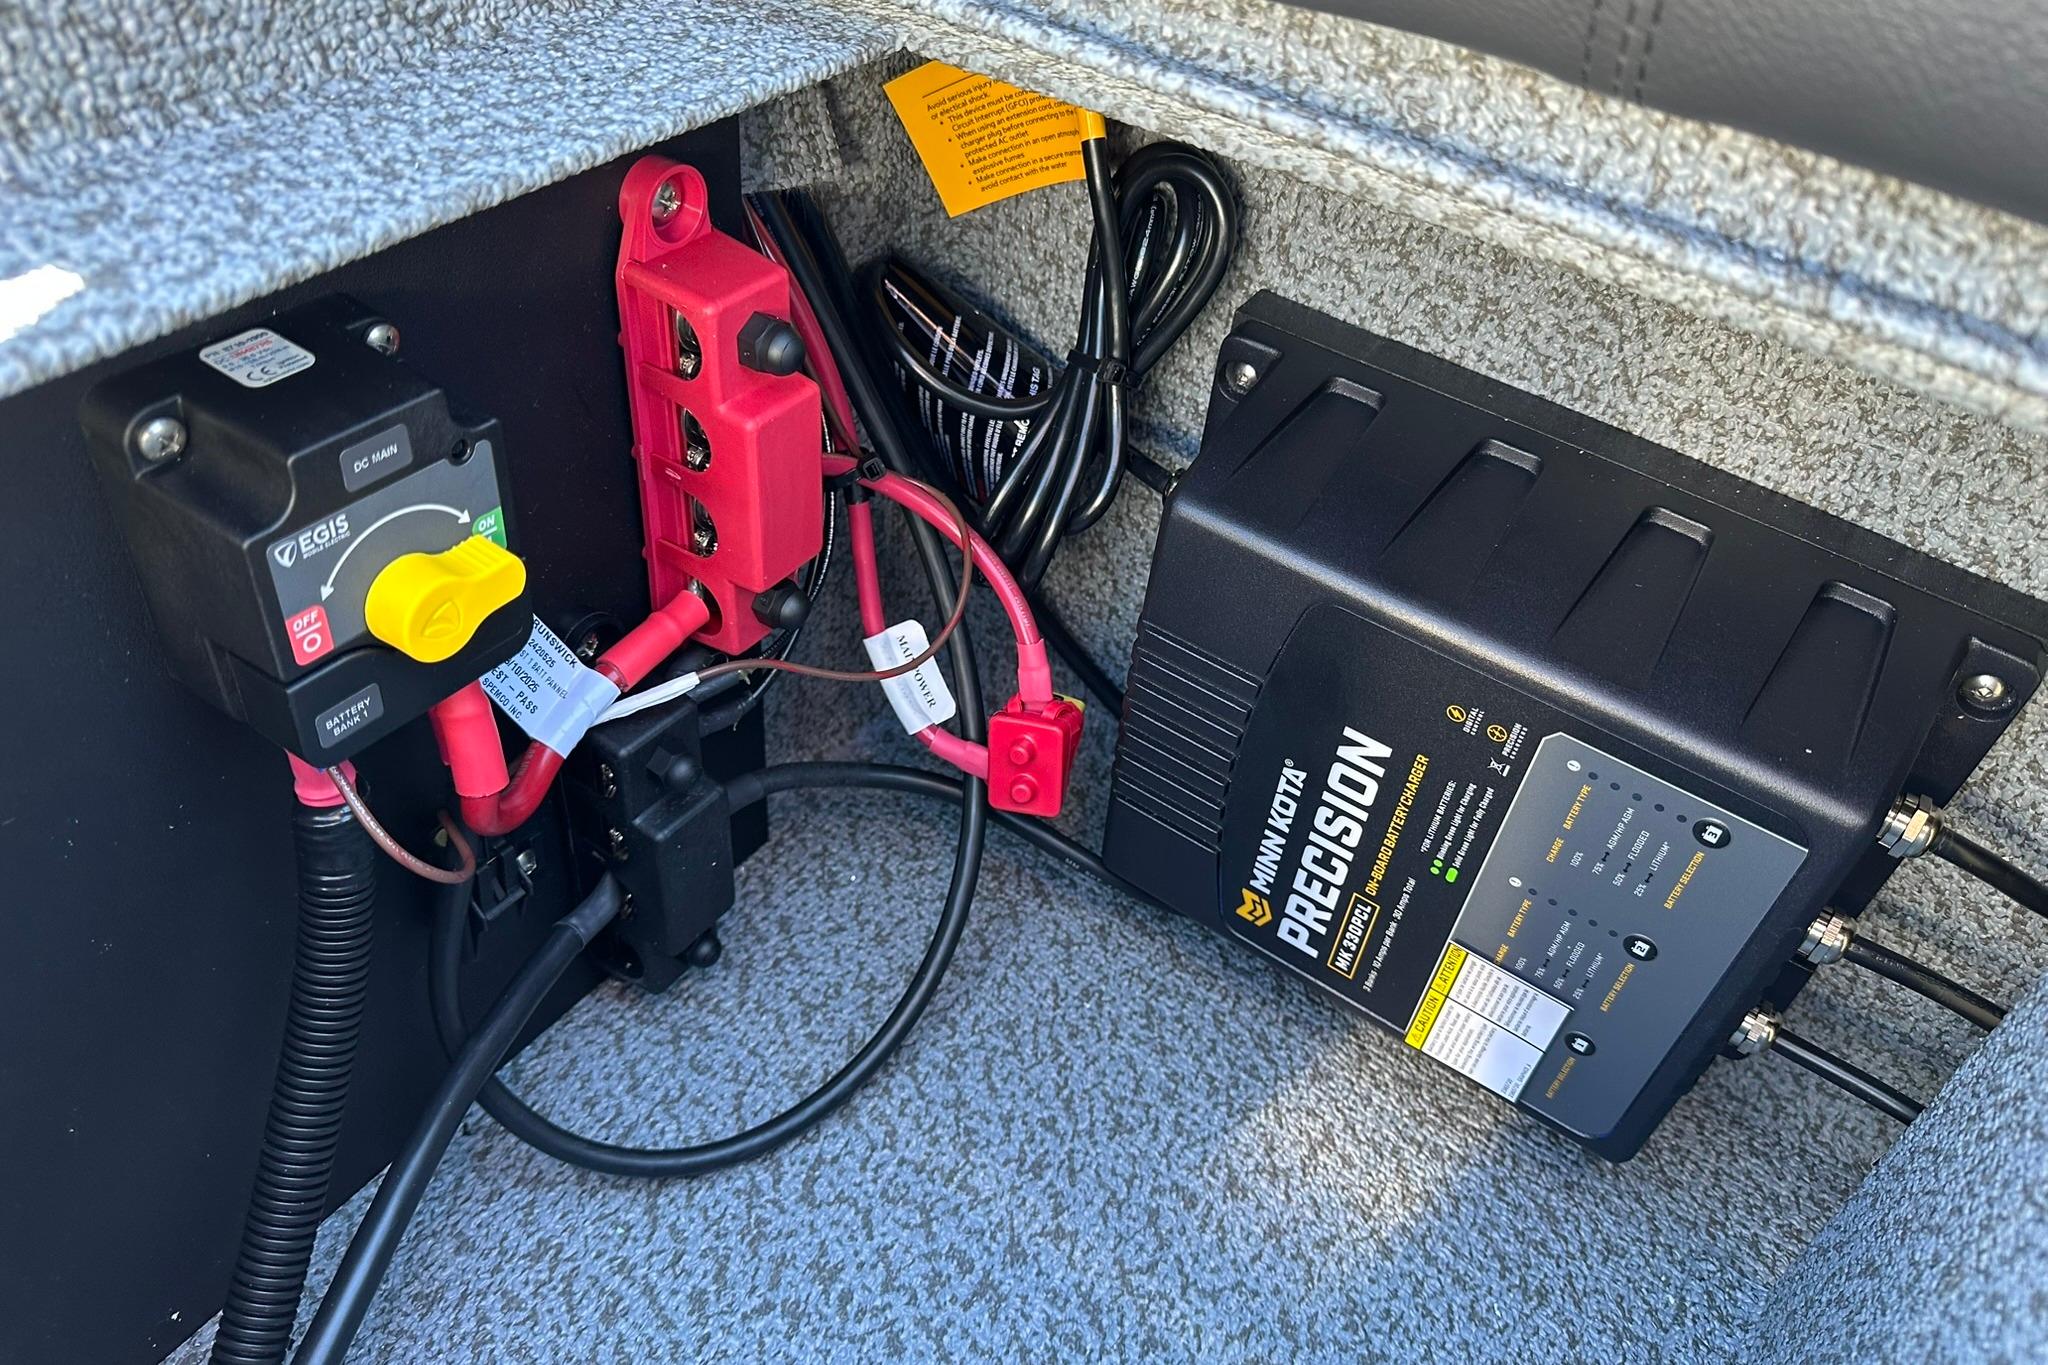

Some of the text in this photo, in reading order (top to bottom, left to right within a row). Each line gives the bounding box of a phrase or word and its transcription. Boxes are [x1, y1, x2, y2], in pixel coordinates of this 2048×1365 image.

[927, 80, 992, 112] Avoid serious injury
[948, 113, 963, 123] This
[963, 104, 986, 117] device
[986, 96, 1004, 108] must
[968, 91, 989, 104] shock.
[951, 97, 1029, 132] Circuit Interrupt (GFCI)
[955, 129, 976, 140] When
[976, 121, 996, 133] using
[1005, 107, 1037, 122] extension
[1038, 102, 1053, 112] cord,
[960, 135, 986, 149] charger
[987, 129, 1003, 140] plug
[1001, 121, 1024, 134] before
[1025, 112, 1059, 126] connecting
[964, 130, 1029, 159] protected AC outlet
[968, 156, 987, 166] Make
[987, 142, 1024, 159] connection
[1040, 133, 1056, 143] open
[1003, 152, 1024, 163] fumes
[976, 172, 995, 183] Make
[996, 161, 1031, 177] connection
[1043, 152, 1064, 162] secure
[981, 161, 1067, 192] avoid contact with the water
[1031, 366, 1041, 384] TAG
[354, 443, 398, 473] DC MAIN
[298, 513, 349, 554] EGIS
[478, 515, 496, 532] ON
[303, 530, 351, 560] MOBILE ELECTRIC
[293, 611, 319, 633] OFF
[527, 638, 557, 668] 2420525
[533, 618, 578, 669] RUNSWICK
[533, 661, 548, 677] BATT
[545, 676, 569, 700] PANNEL
[325, 696, 371, 731] BATTERY
[481, 677, 522, 722] SPEMCO INC.
[515, 690, 539, 715] PASS
[333, 713, 361, 737] BANK
[1462, 707, 1479, 733] DIGITAL
[1502, 723, 1522, 757] PRECISION
[1426, 814, 1442, 840] LITHIUM
[1436, 780, 1457, 815] BATTERIES:
[1436, 783, 1477, 860] Blinking Green Light for Charging
[1546, 784, 1592, 863] CHARGE BATTERY TYPE
[1276, 725, 1393, 959] PRECISION
[1452, 786, 1494, 868] Solid Green Light for Fully Charged
[1592, 807, 1635, 875] 75% AGM/HP AGM
[1249, 829, 1286, 895] MINN
[1335, 754, 1429, 971] MK 330PCL ON-BOARD BATTERY CHARGER
[1570, 851, 1584, 867] 100%
[1612, 830, 1650, 886] 50% FLOODED
[1403, 876, 1416, 894] Total
[1633, 883, 1647, 897] 25%
[1664, 851, 1705, 909] BATTERY SELECTION
[1392, 909, 1403, 920] 30
[1396, 893, 1410, 912] Amps
[1385, 921, 1398, 937] Bank
[1507, 912, 1524, 938] BATTERY
[1519, 899, 1532, 914] TYPE
[1375, 945, 1388, 963] Amps
[1382, 935, 1392, 948] per
[1534, 920, 1571, 978] 75% AGM/HP AGM
[1364, 970, 1378, 987] Banks
[1372, 960, 1381, 969] 10
[1438, 947, 1463, 984] ATTENTION
[1514, 957, 1527, 971] 100%
[1553, 941, 1585, 989] 50% FLOODED
[1572, 988, 1584, 1000] 25%
[1600, 962, 1635, 1012] BATTERY SELECTION
[1414, 995, 1439, 1033] CAUTION
[1556, 1056, 1576, 1081] SELECTION
